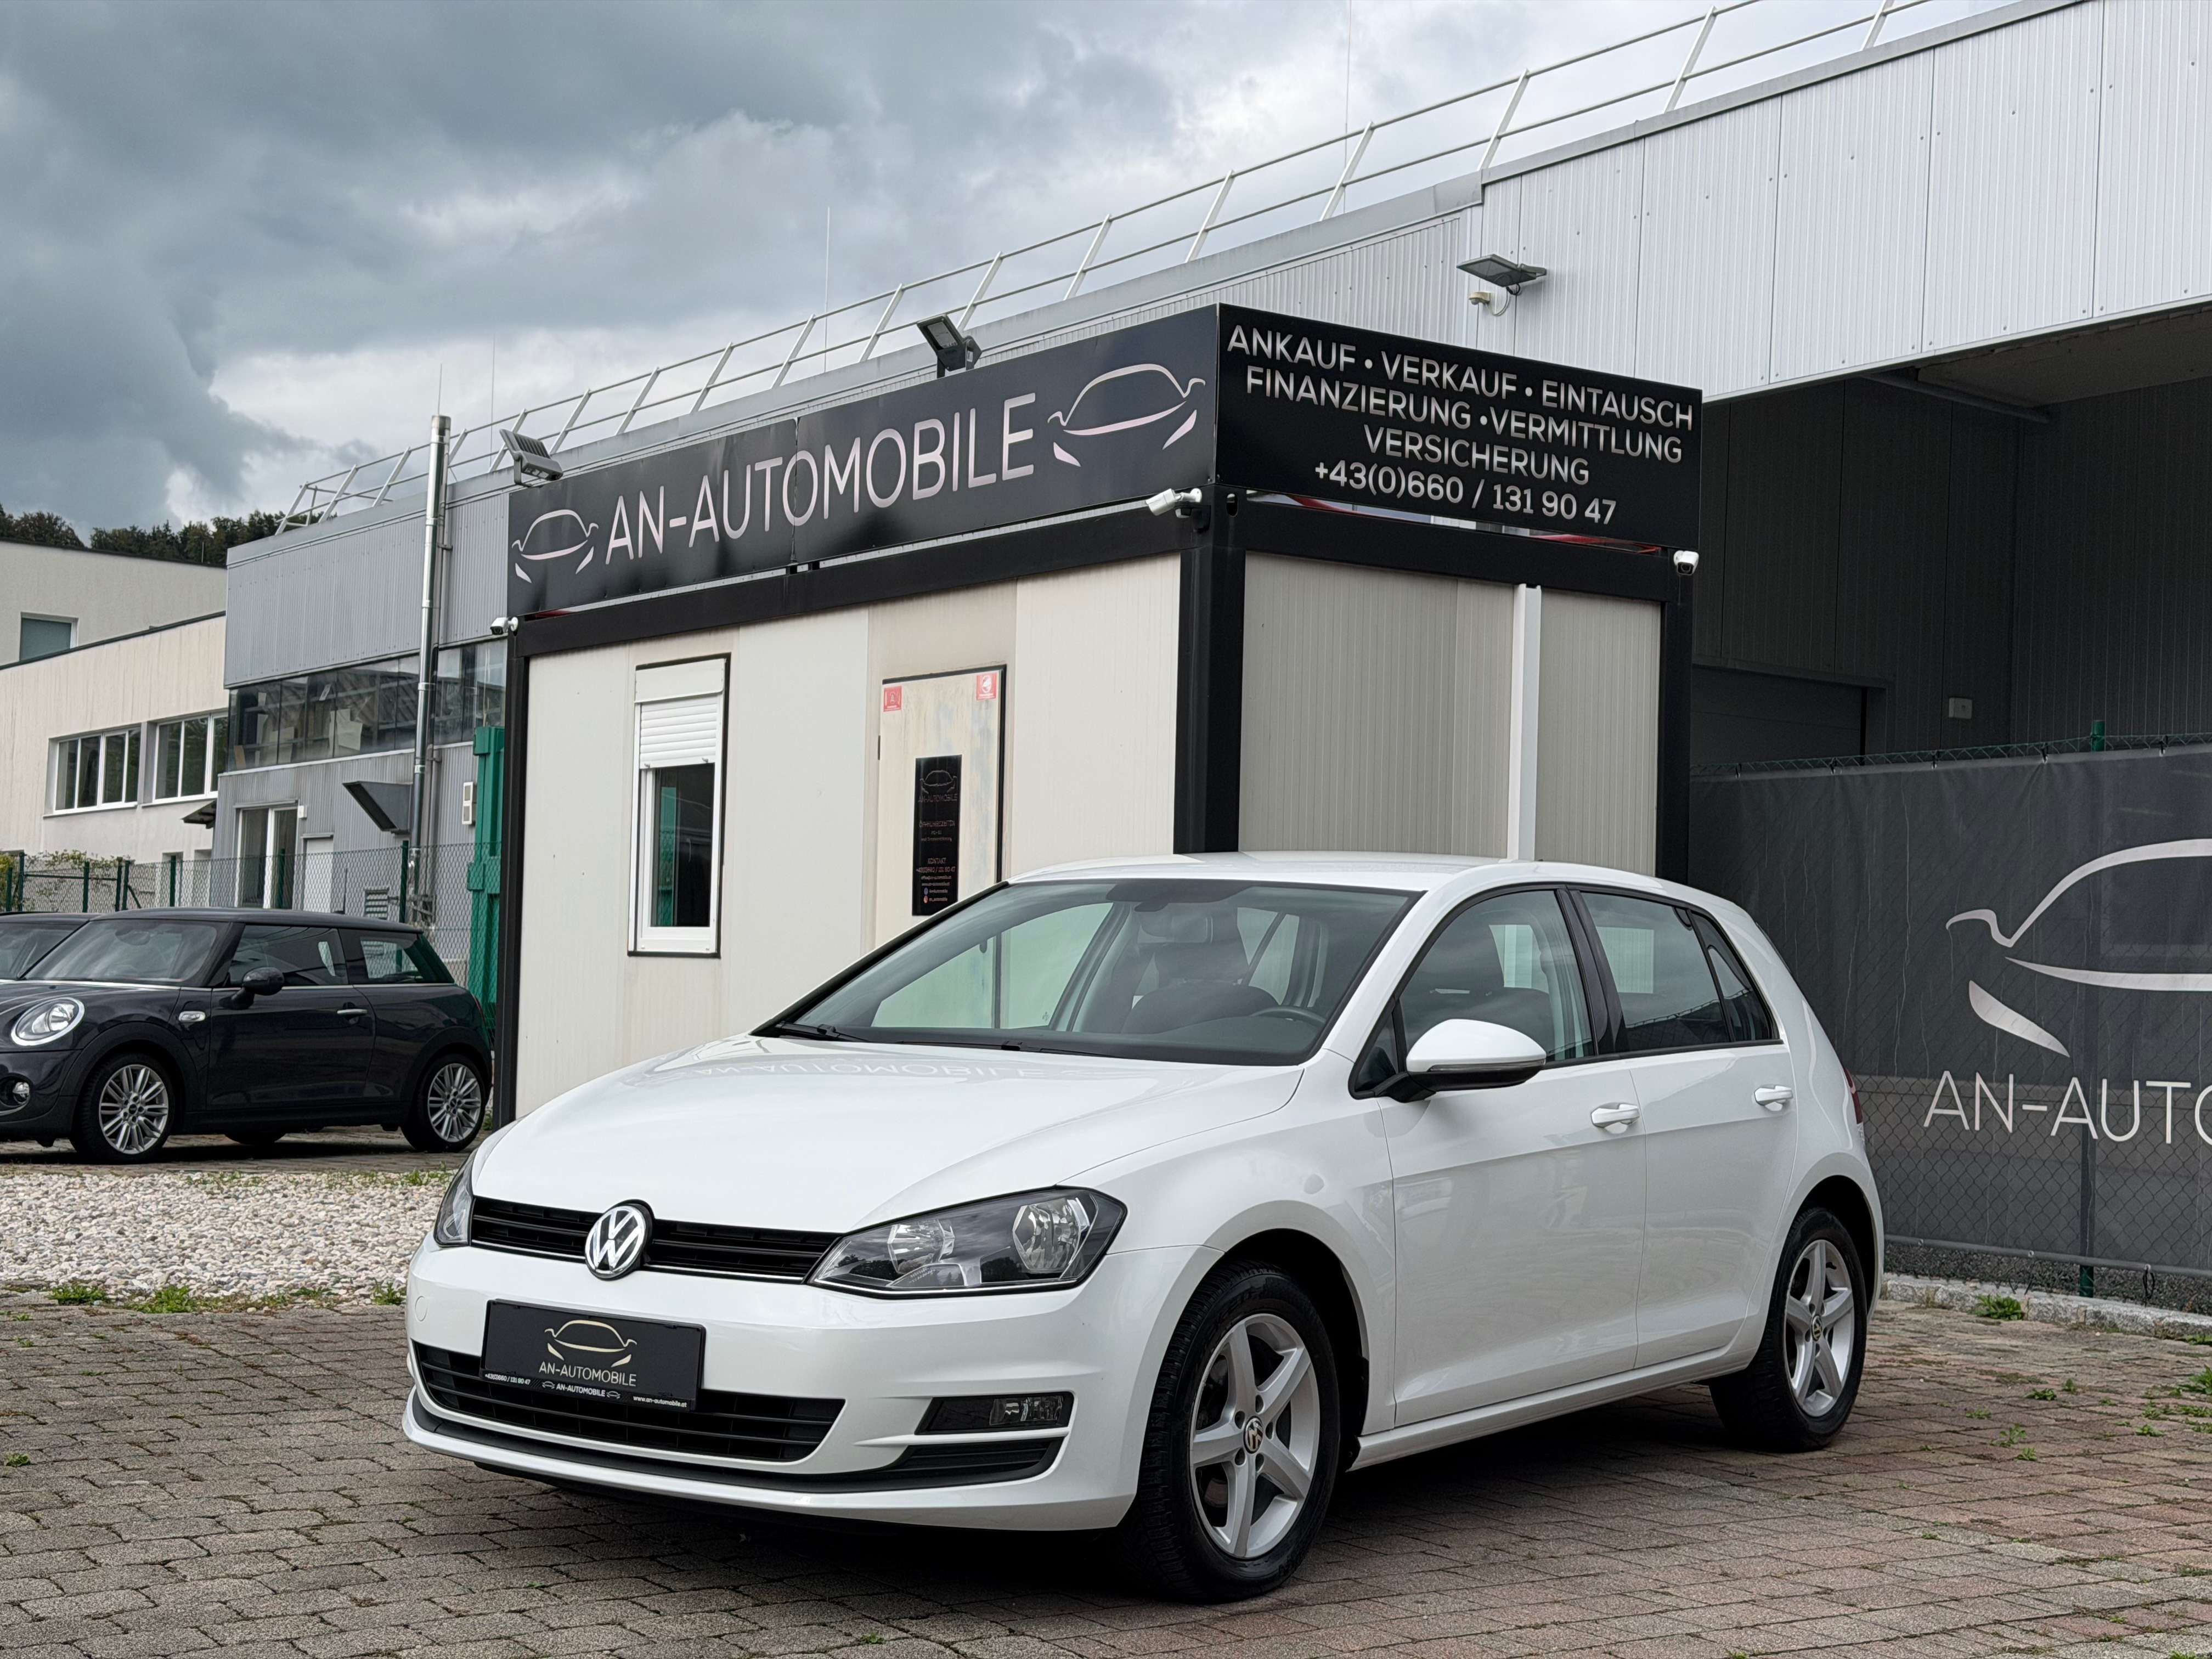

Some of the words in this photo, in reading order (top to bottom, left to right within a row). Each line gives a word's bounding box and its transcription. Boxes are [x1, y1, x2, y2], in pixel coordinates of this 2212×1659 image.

[1227, 325, 1356, 371] ANKAUF
[1381, 351, 1517, 399] VERKAUF
[1542, 380, 1692, 430] EINTAUSCH
[1247, 365, 1471, 429] FINANZIERUNG
[605, 392, 1036, 565] AN-AUTOMOBILE
[1364, 425, 1589, 485] VERSICHERUNG
[1315, 460, 1463, 503] +43(0)660
[1493, 484, 1533, 514] 131
[1542, 491, 1577, 520] 90
[1584, 498, 1616, 524] 47
[539, 1361, 637, 1387] AN-AUTOMOBILE
[556, 1383, 606, 1397] AN-AUTOMOBILE
[633, 1395, 687, 1408] www.an-automobile.at
